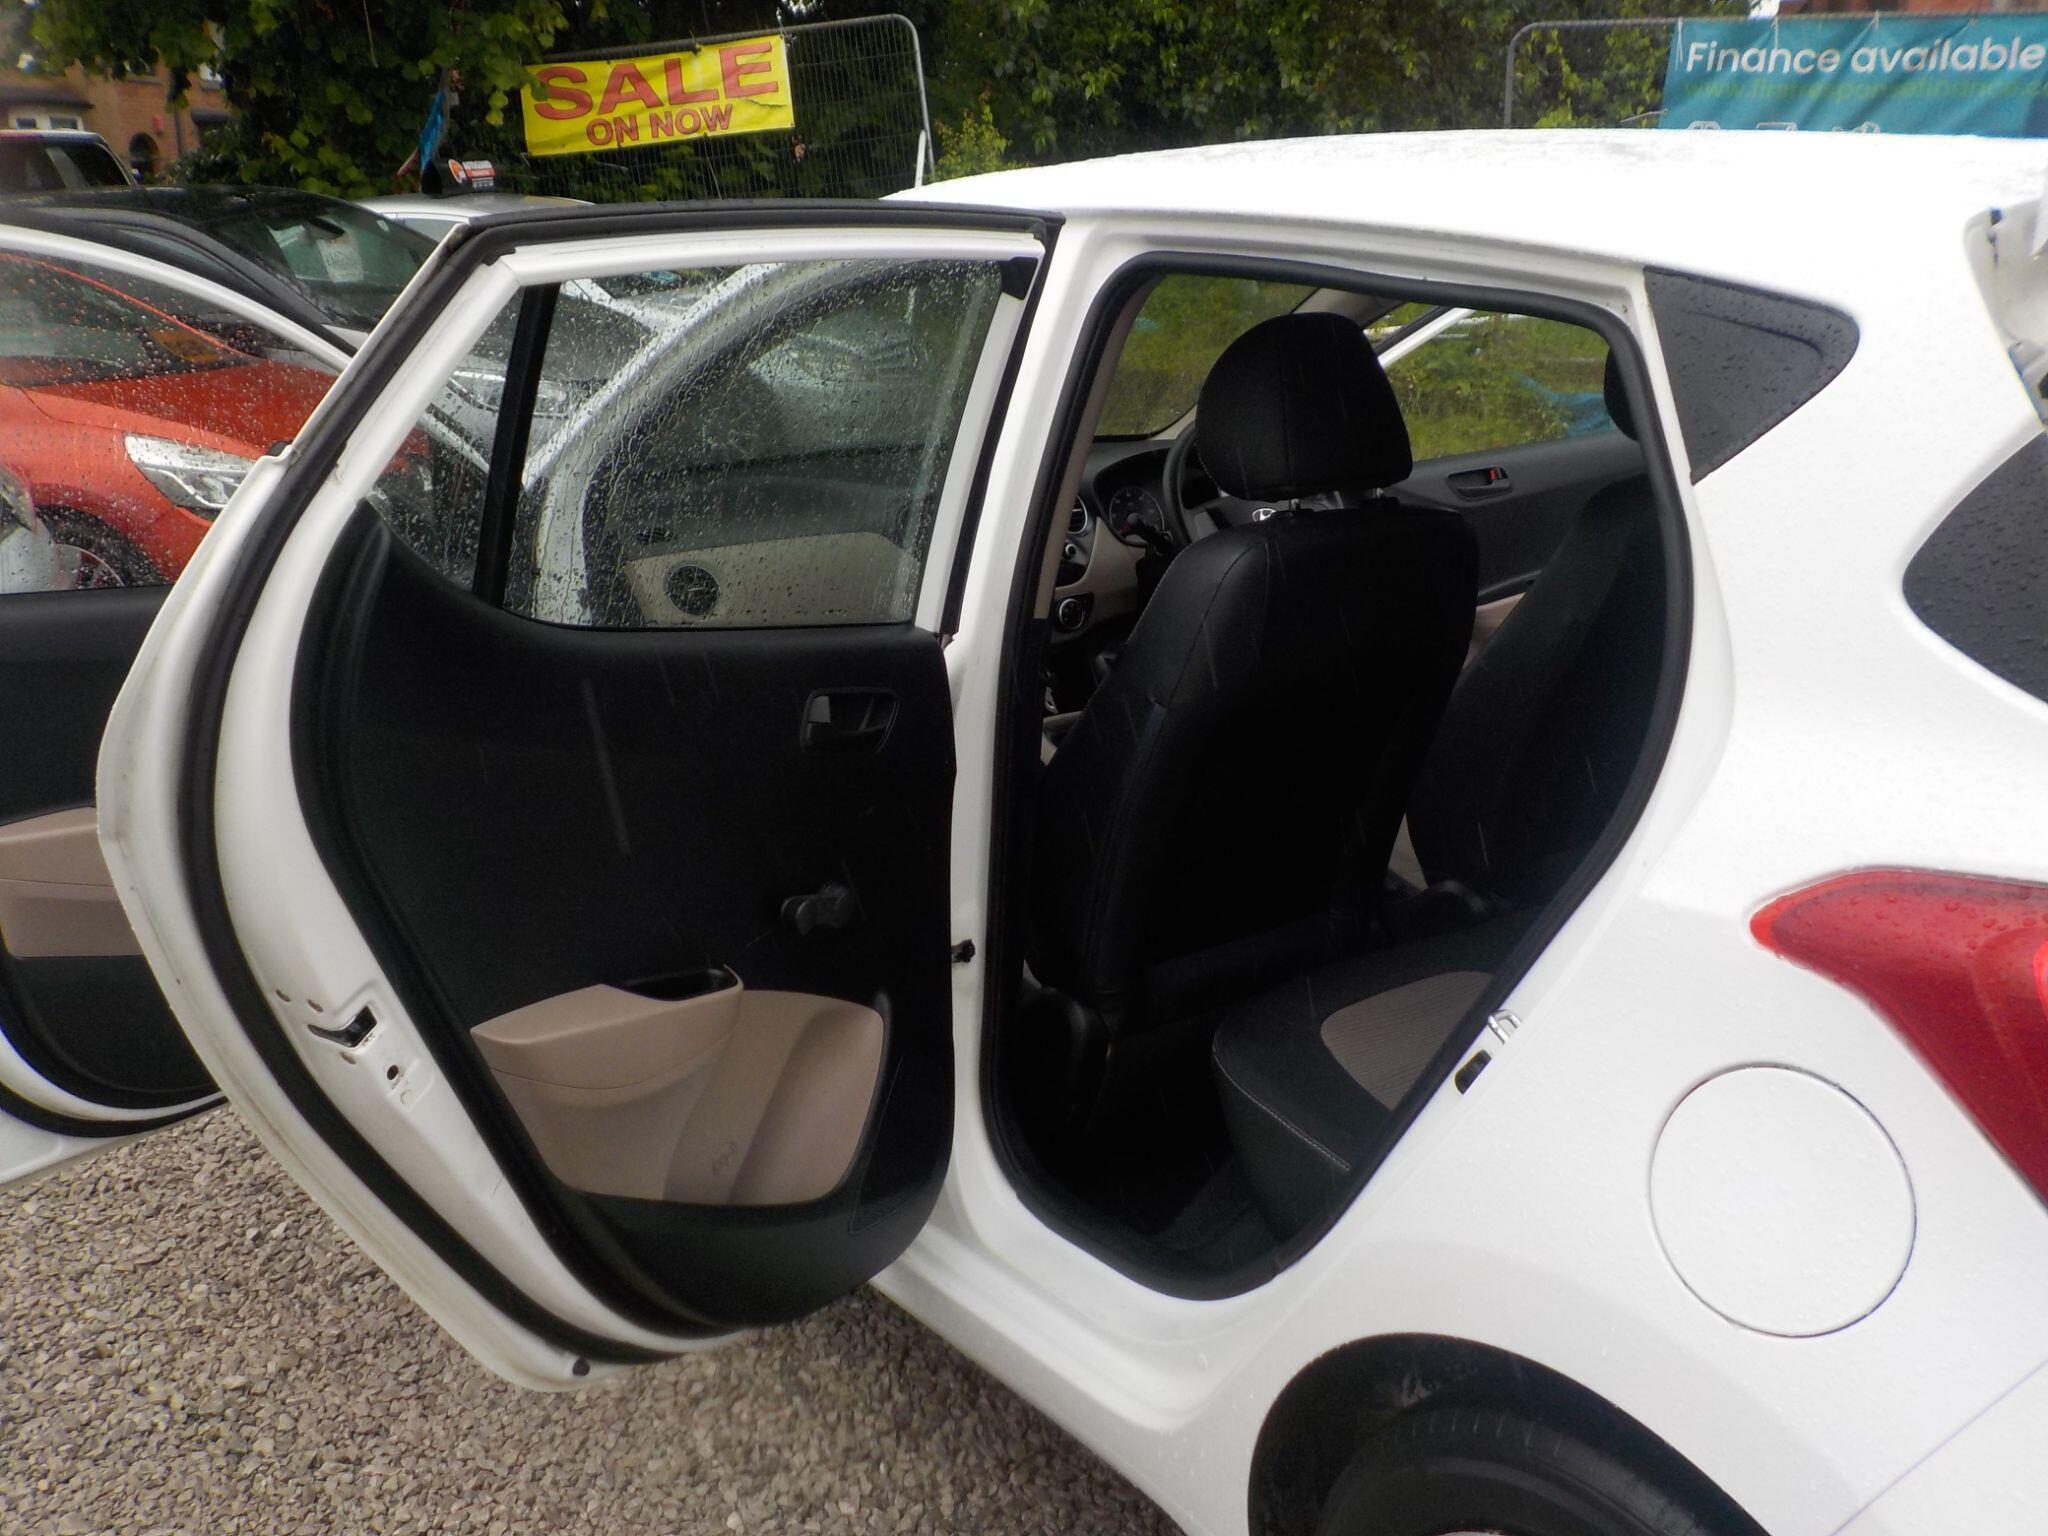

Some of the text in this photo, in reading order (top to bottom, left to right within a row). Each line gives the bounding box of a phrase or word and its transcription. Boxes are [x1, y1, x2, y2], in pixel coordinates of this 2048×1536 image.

[1686, 36, 2046, 74] Finance available
[534, 42, 779, 120] SALE
[586, 104, 733, 146] ON NOW
